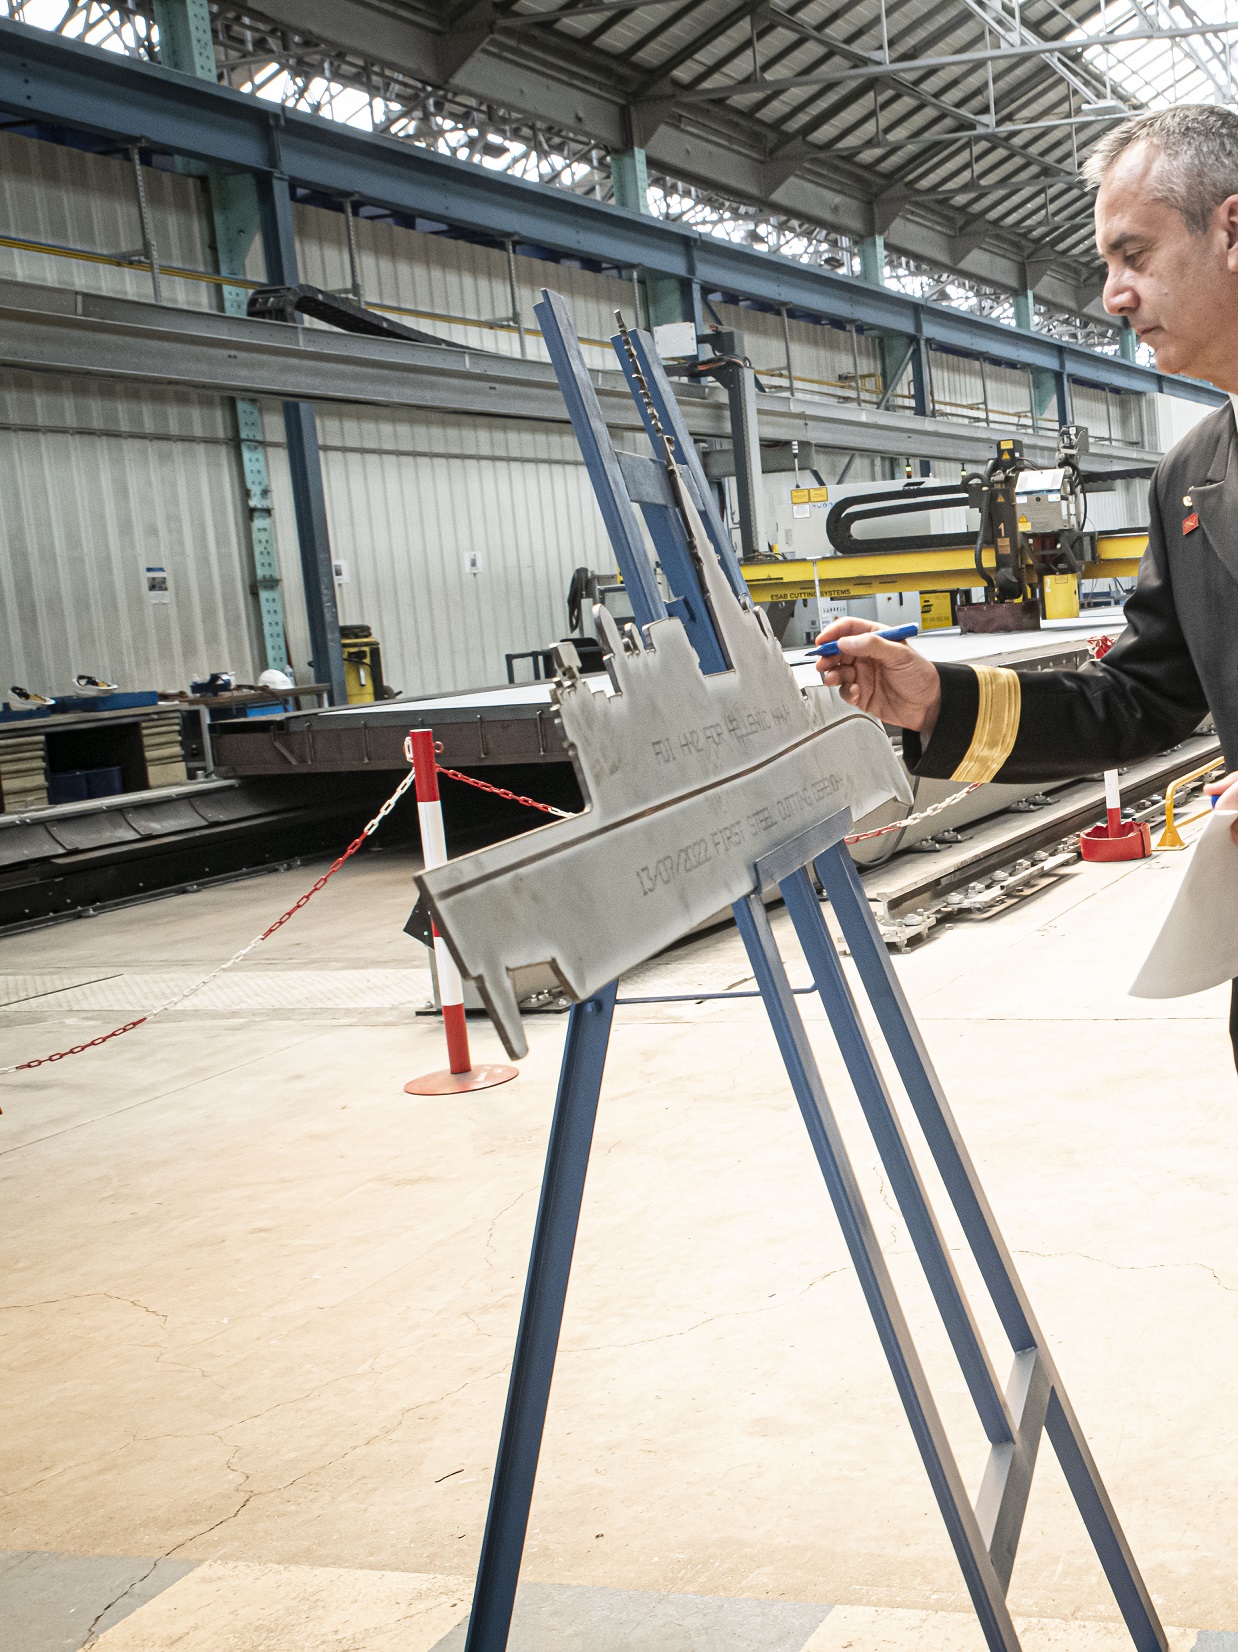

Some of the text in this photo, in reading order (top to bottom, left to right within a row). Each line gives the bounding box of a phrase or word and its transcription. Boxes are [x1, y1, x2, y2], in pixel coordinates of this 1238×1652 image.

[820, 589, 851, 598] SYSTEMS
[710, 820, 747, 854] FIRST
[746, 807, 778, 837] STEEL
